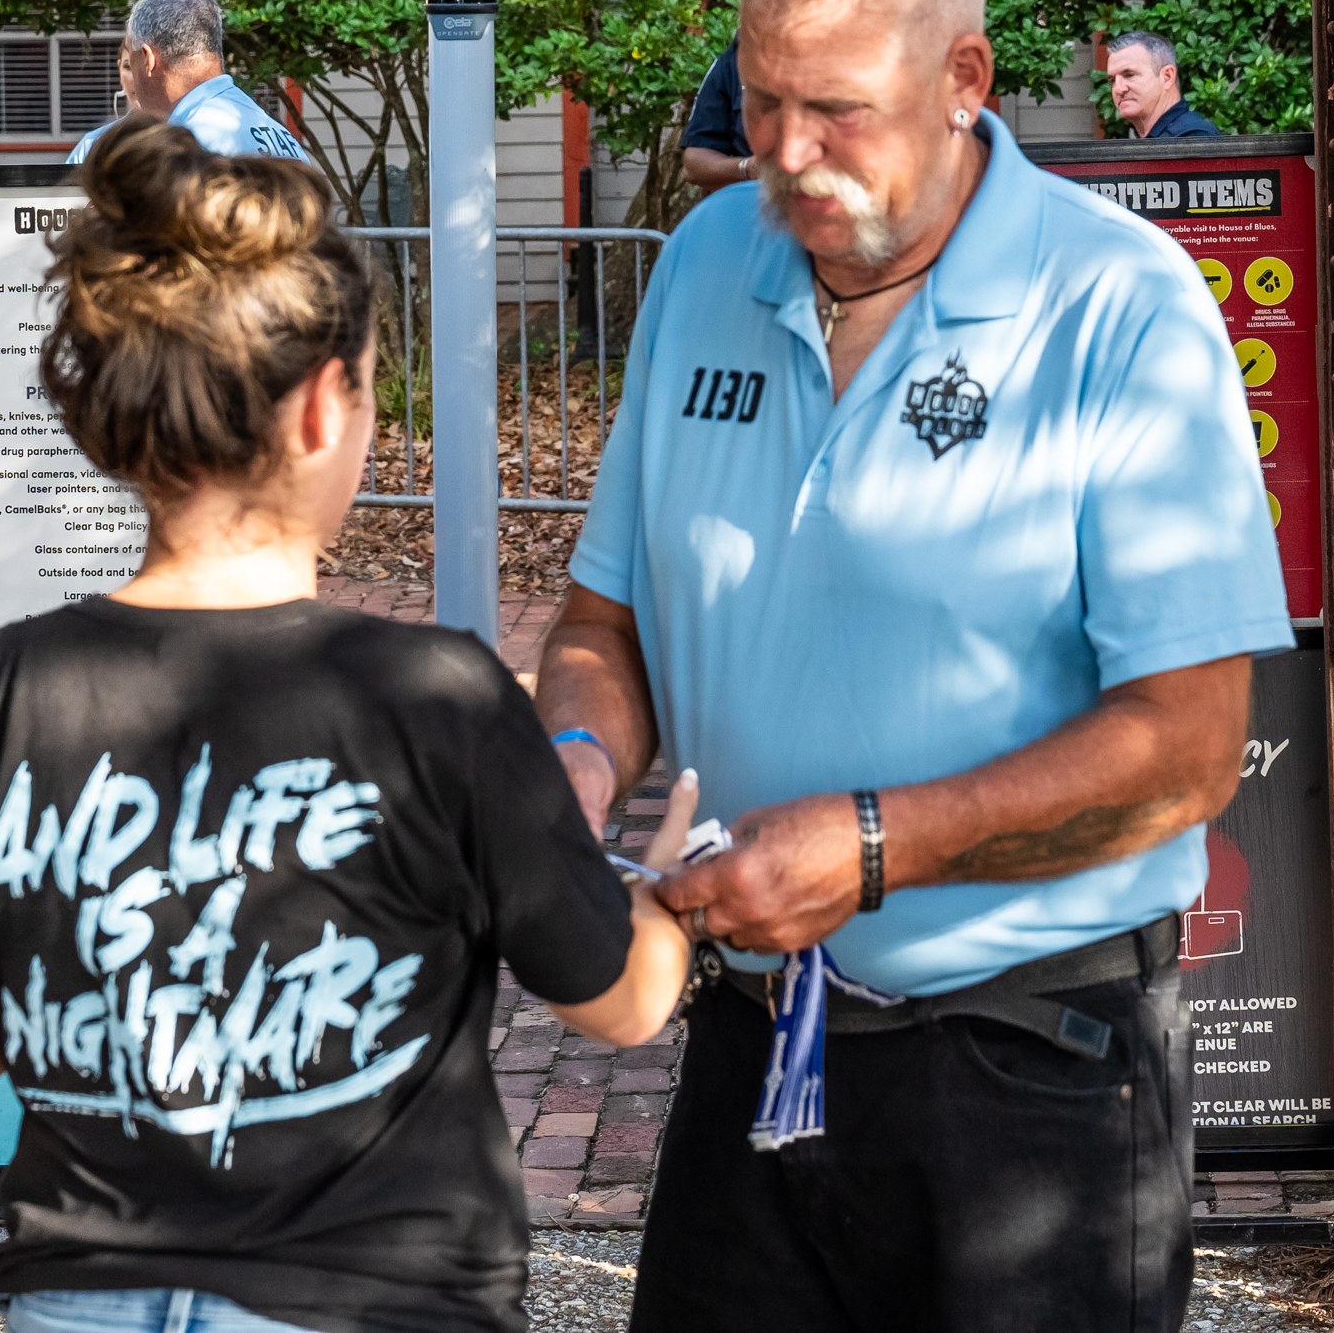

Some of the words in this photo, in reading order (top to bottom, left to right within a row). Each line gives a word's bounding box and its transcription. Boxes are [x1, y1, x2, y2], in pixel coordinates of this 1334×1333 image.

[1187, 177, 1274, 208] ITEMS
[1192, 224, 1208, 232] visit
[1209, 224, 1217, 232] to
[1219, 224, 1243, 232] House
[1244, 223, 1253, 231] of
[1254, 222, 1277, 231] Blues,
[1203, 235, 1218, 243] into
[1219, 235, 1231, 243] the
[1233, 235, 1259, 243] venue:
[7, 283, 60, 295] well-being
[18, 322, 52, 332] Please
[29, 345, 43, 355] th
[681, 367, 766, 425] 1130
[9, 411, 45, 422] knives,
[20, 426, 48, 435] other
[0, 446, 24, 458] drug
[31, 470, 78, 480] cameras,
[27, 484, 53, 494] laser
[55, 484, 100, 495] pointers,
[102, 484, 121, 493] and
[72, 506, 84, 514] or
[86, 506, 105, 516] any
[107, 504, 126, 516] bag
[64, 521, 93, 531] Clear
[95, 521, 115, 533] Bag
[117, 521, 148, 533] Policy
[34, 544, 63, 554] Glass
[65, 544, 119, 554] containers
[122, 544, 133, 554] of
[38, 567, 78, 577] Outside
[80, 567, 103, 577] food
[106, 567, 125, 577] and
[64, 591, 93, 602] Large
[169, 742, 384, 896] LIFE
[75, 866, 170, 978] IS
[169, 874, 247, 995] A
[1219, 997, 1298, 1011] ALLOWED
[1203, 1025, 1213, 1035] x
[1241, 1021, 1274, 1034] ARE
[0, 919, 424, 1168] NIGHTMARE
[1193, 1060, 1271, 1075] CHECKED
[1213, 1100, 1266, 1113] CLEAR
[1268, 1098, 1309, 1111] WILL
[1312, 1097, 1332, 1110] BE
